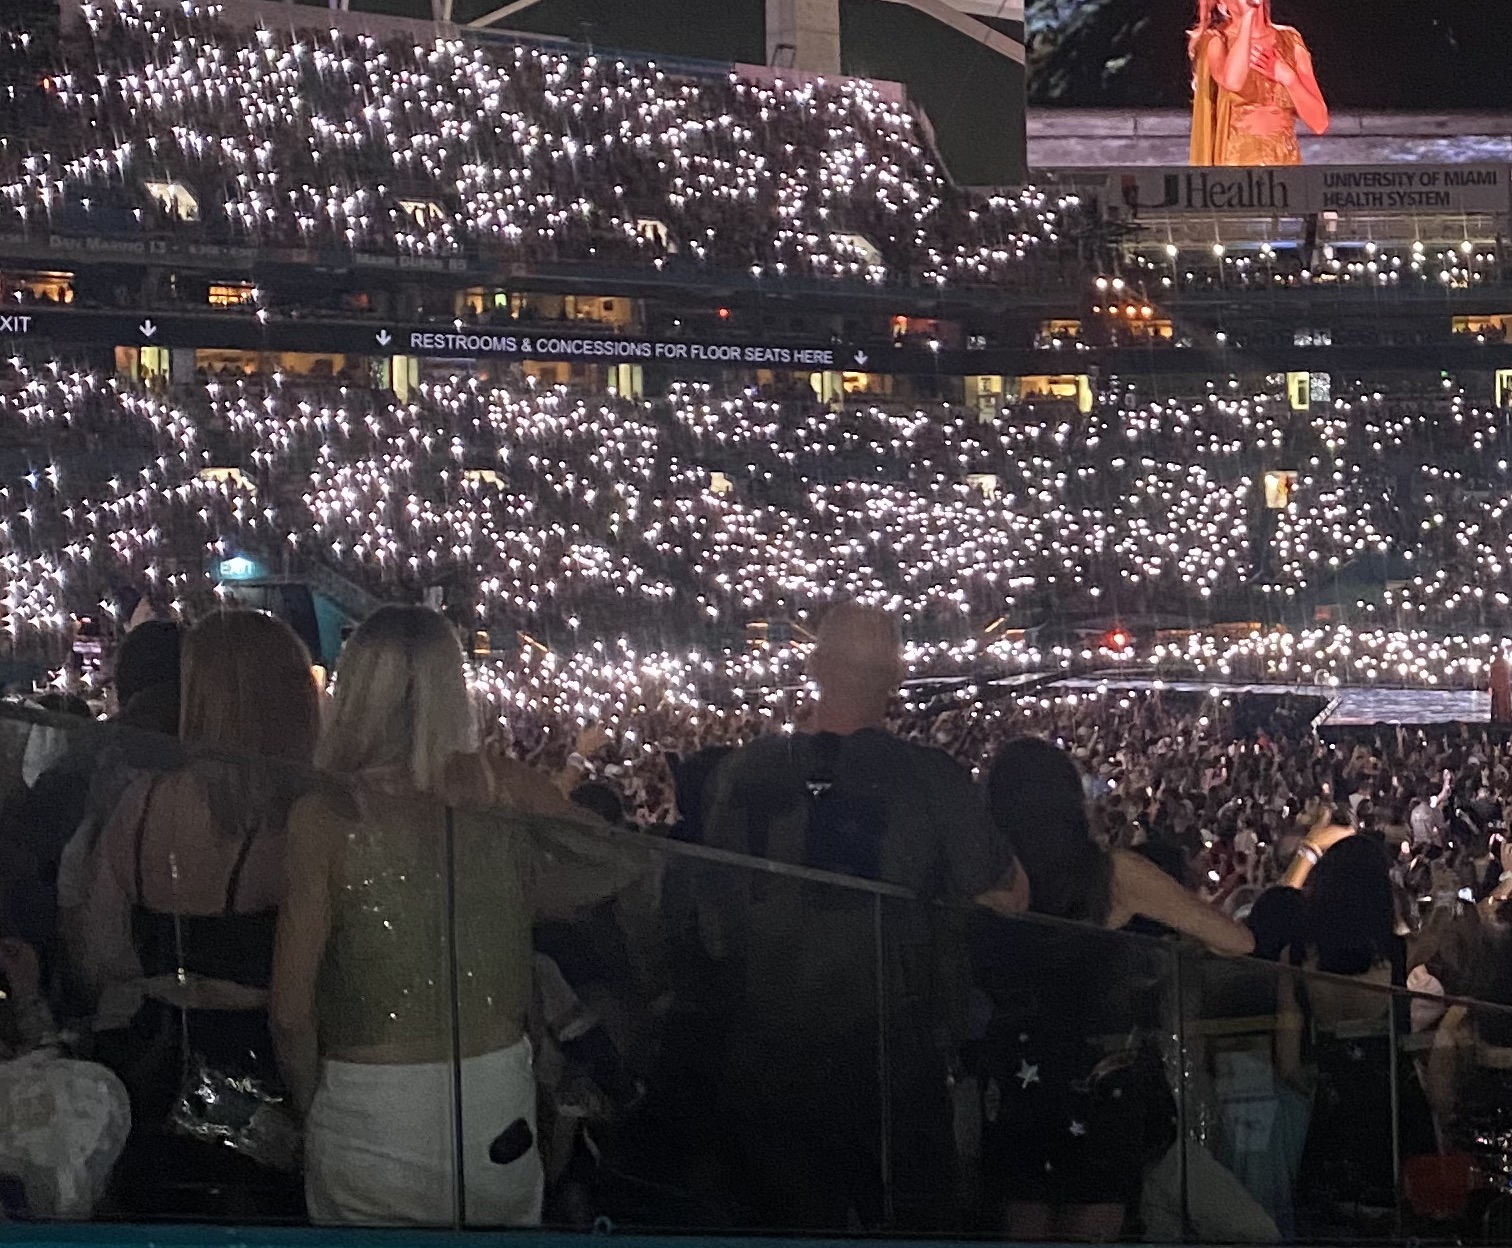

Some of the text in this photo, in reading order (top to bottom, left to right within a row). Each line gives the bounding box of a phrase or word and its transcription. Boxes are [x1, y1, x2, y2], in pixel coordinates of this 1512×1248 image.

[1324, 170, 1497, 187] UNIVERSITY OF MIAMI
[1323, 190, 1450, 208] HEALTH SYSTEM
[0, 315, 32, 332] XIT
[410, 333, 834, 365] RESTROOMS & CONCESSIONS FOR FLOOR SEATS HERE
